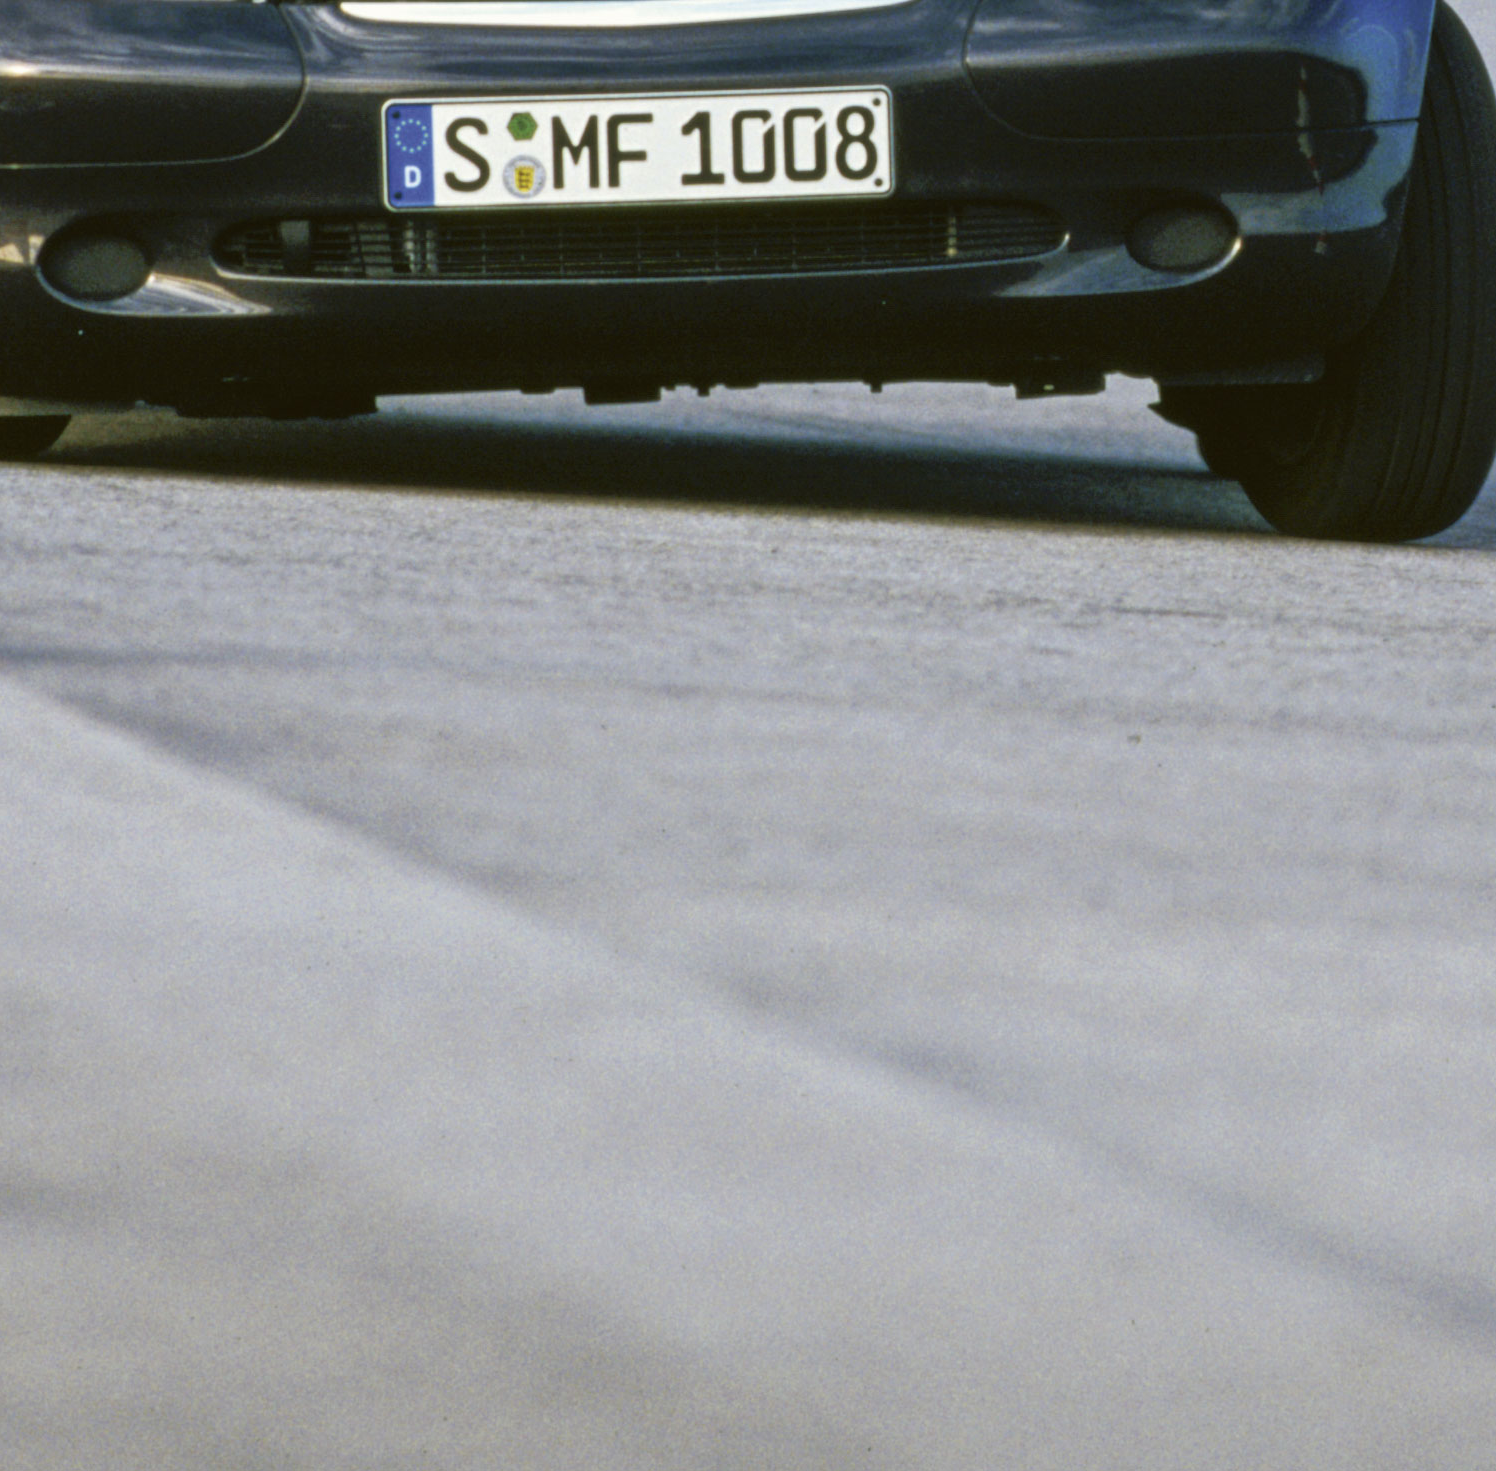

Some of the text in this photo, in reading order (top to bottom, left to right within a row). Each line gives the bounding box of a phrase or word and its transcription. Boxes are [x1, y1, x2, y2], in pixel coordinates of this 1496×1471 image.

[404, 165, 422, 188] D
[443, 105, 879, 193] S MF 1008
